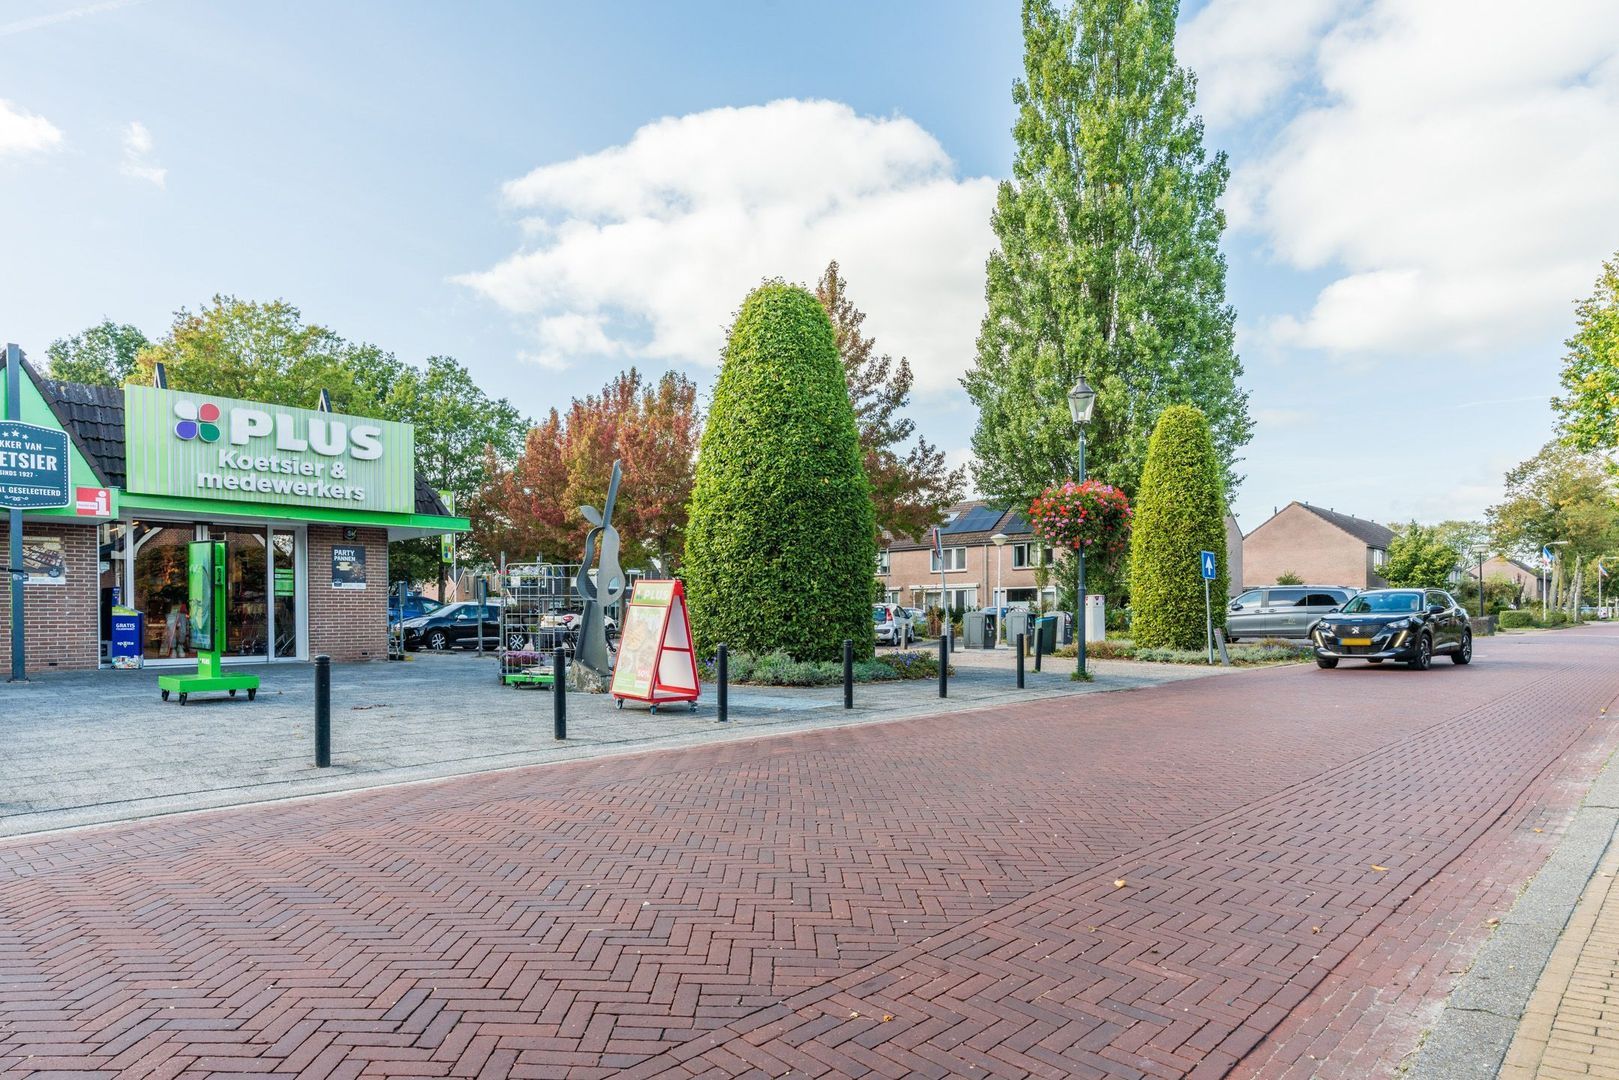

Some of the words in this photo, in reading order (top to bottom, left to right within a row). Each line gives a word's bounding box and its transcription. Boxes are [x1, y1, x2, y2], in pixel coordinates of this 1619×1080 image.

[25, 442, 41, 451] VAN
[230, 407, 384, 461] PLUS
[218, 448, 325, 477] Koetsier
[330, 461, 346, 480] &
[9, 487, 61, 497] GESELECTEERD
[197, 472, 366, 501] medewerkers
